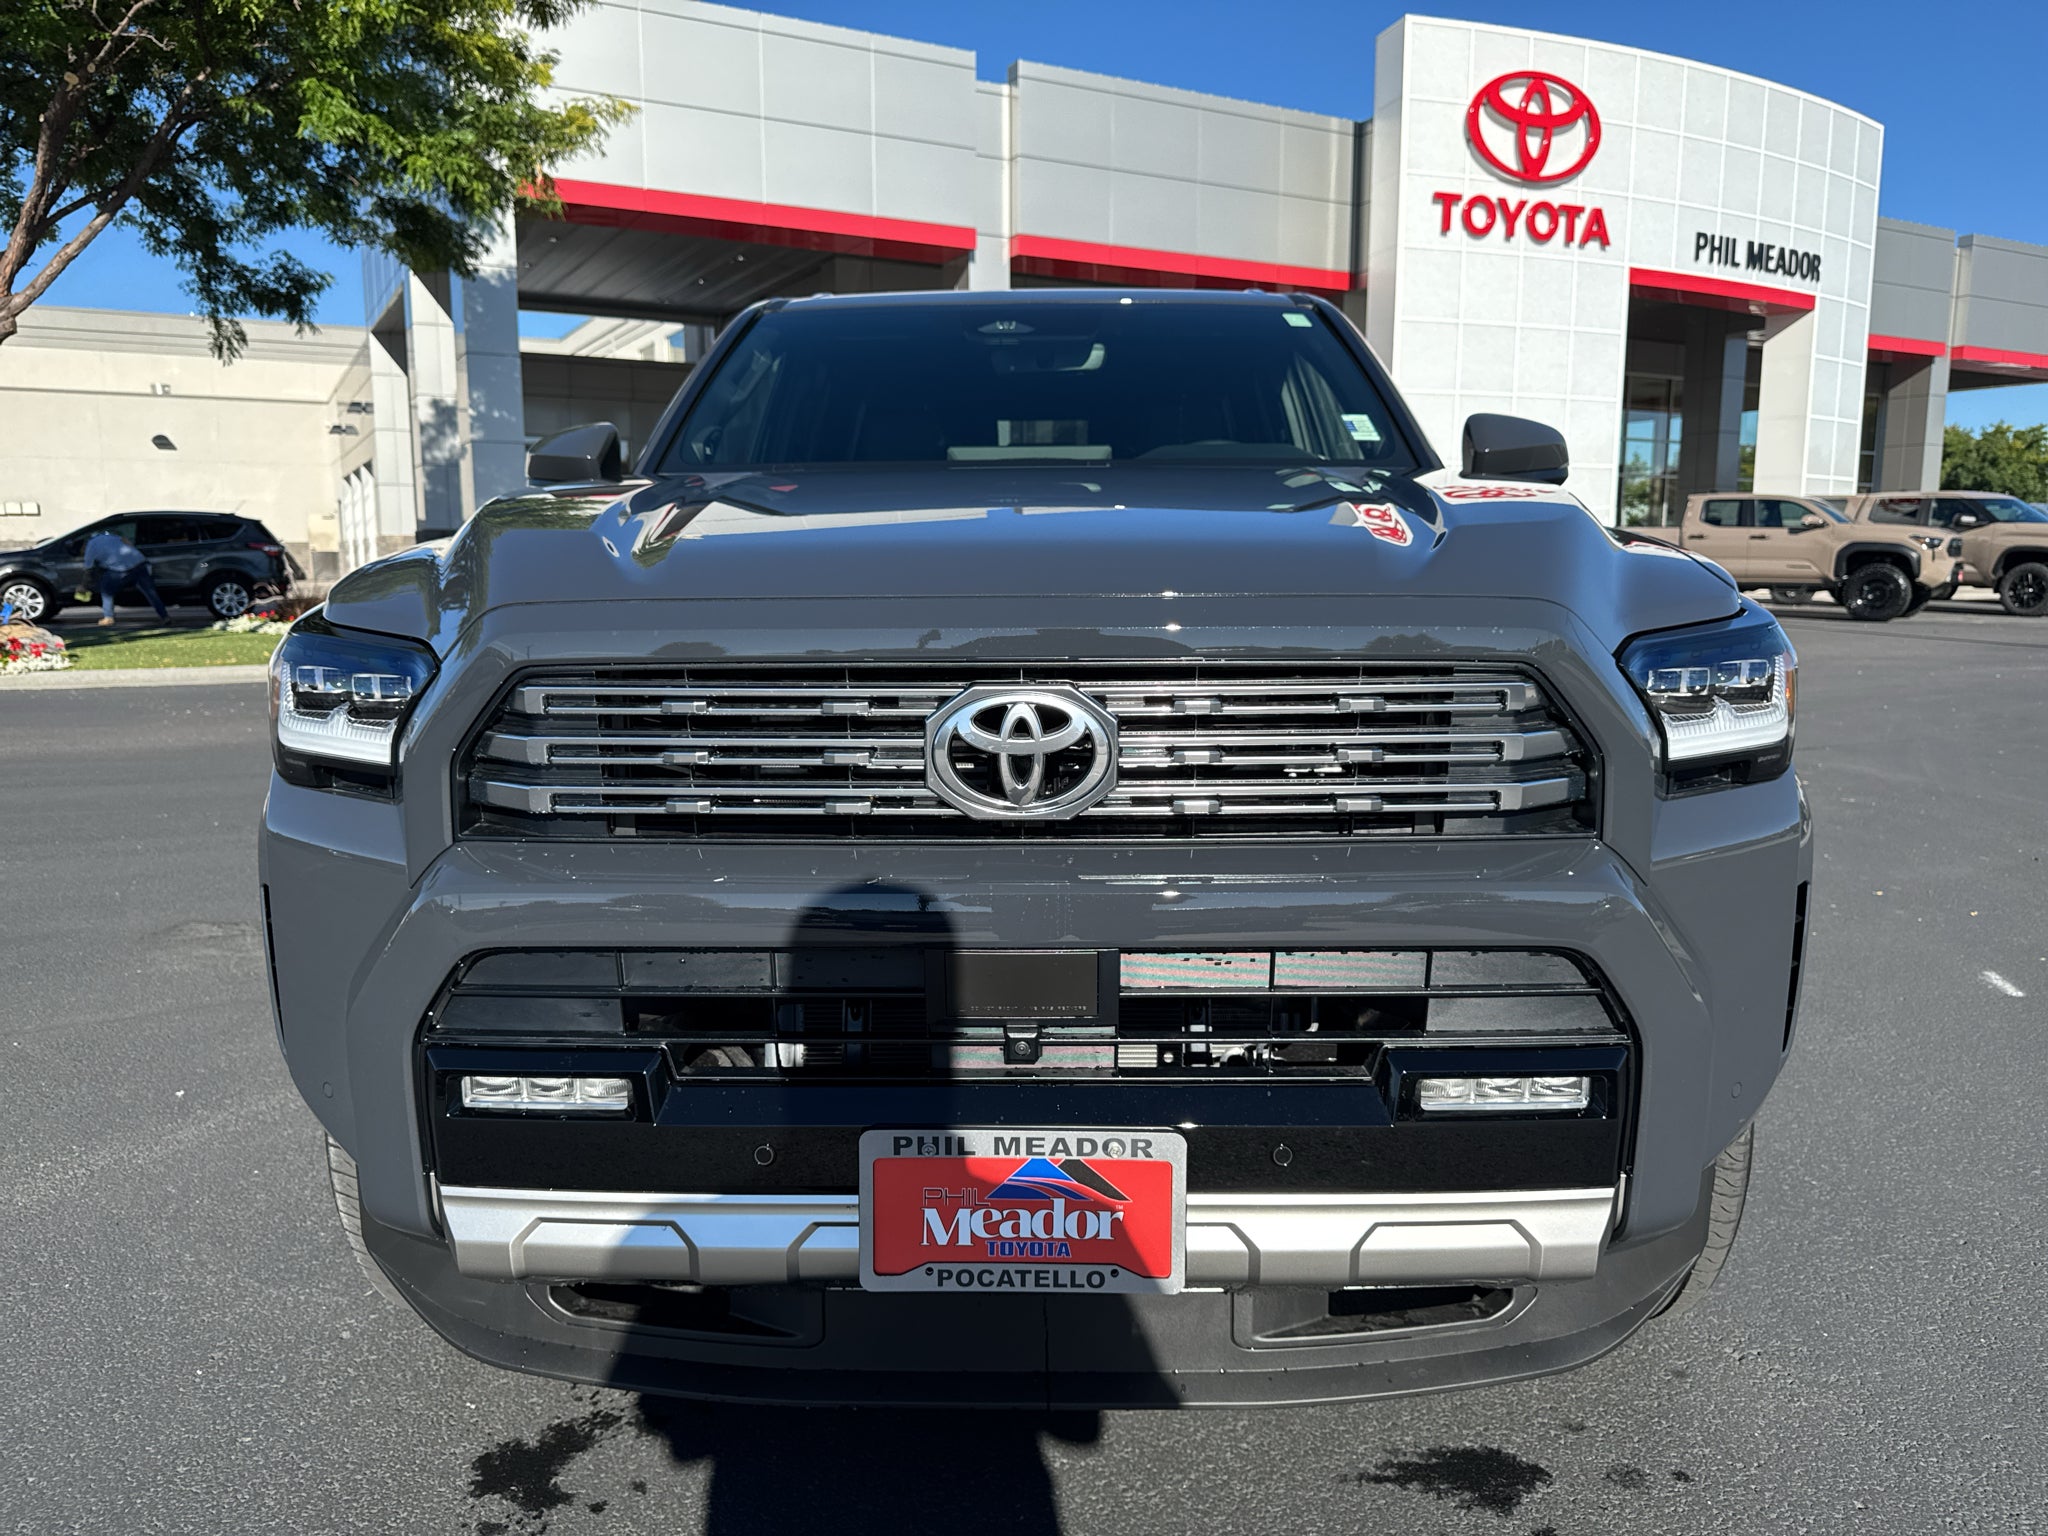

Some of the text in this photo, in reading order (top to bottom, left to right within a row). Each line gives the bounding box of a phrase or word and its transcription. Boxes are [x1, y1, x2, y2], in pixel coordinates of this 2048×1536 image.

[1433, 191, 1611, 249] TOYOTA
[1694, 231, 1822, 283] PHIL MEADOR
[893, 1135, 1154, 1158] PHIL MEADOR
[922, 1187, 991, 1207] PHIL
[920, 1197, 1125, 1246] Meador
[985, 1240, 1072, 1258] TOYOTA
[937, 1268, 1106, 1289] POCATELLO
